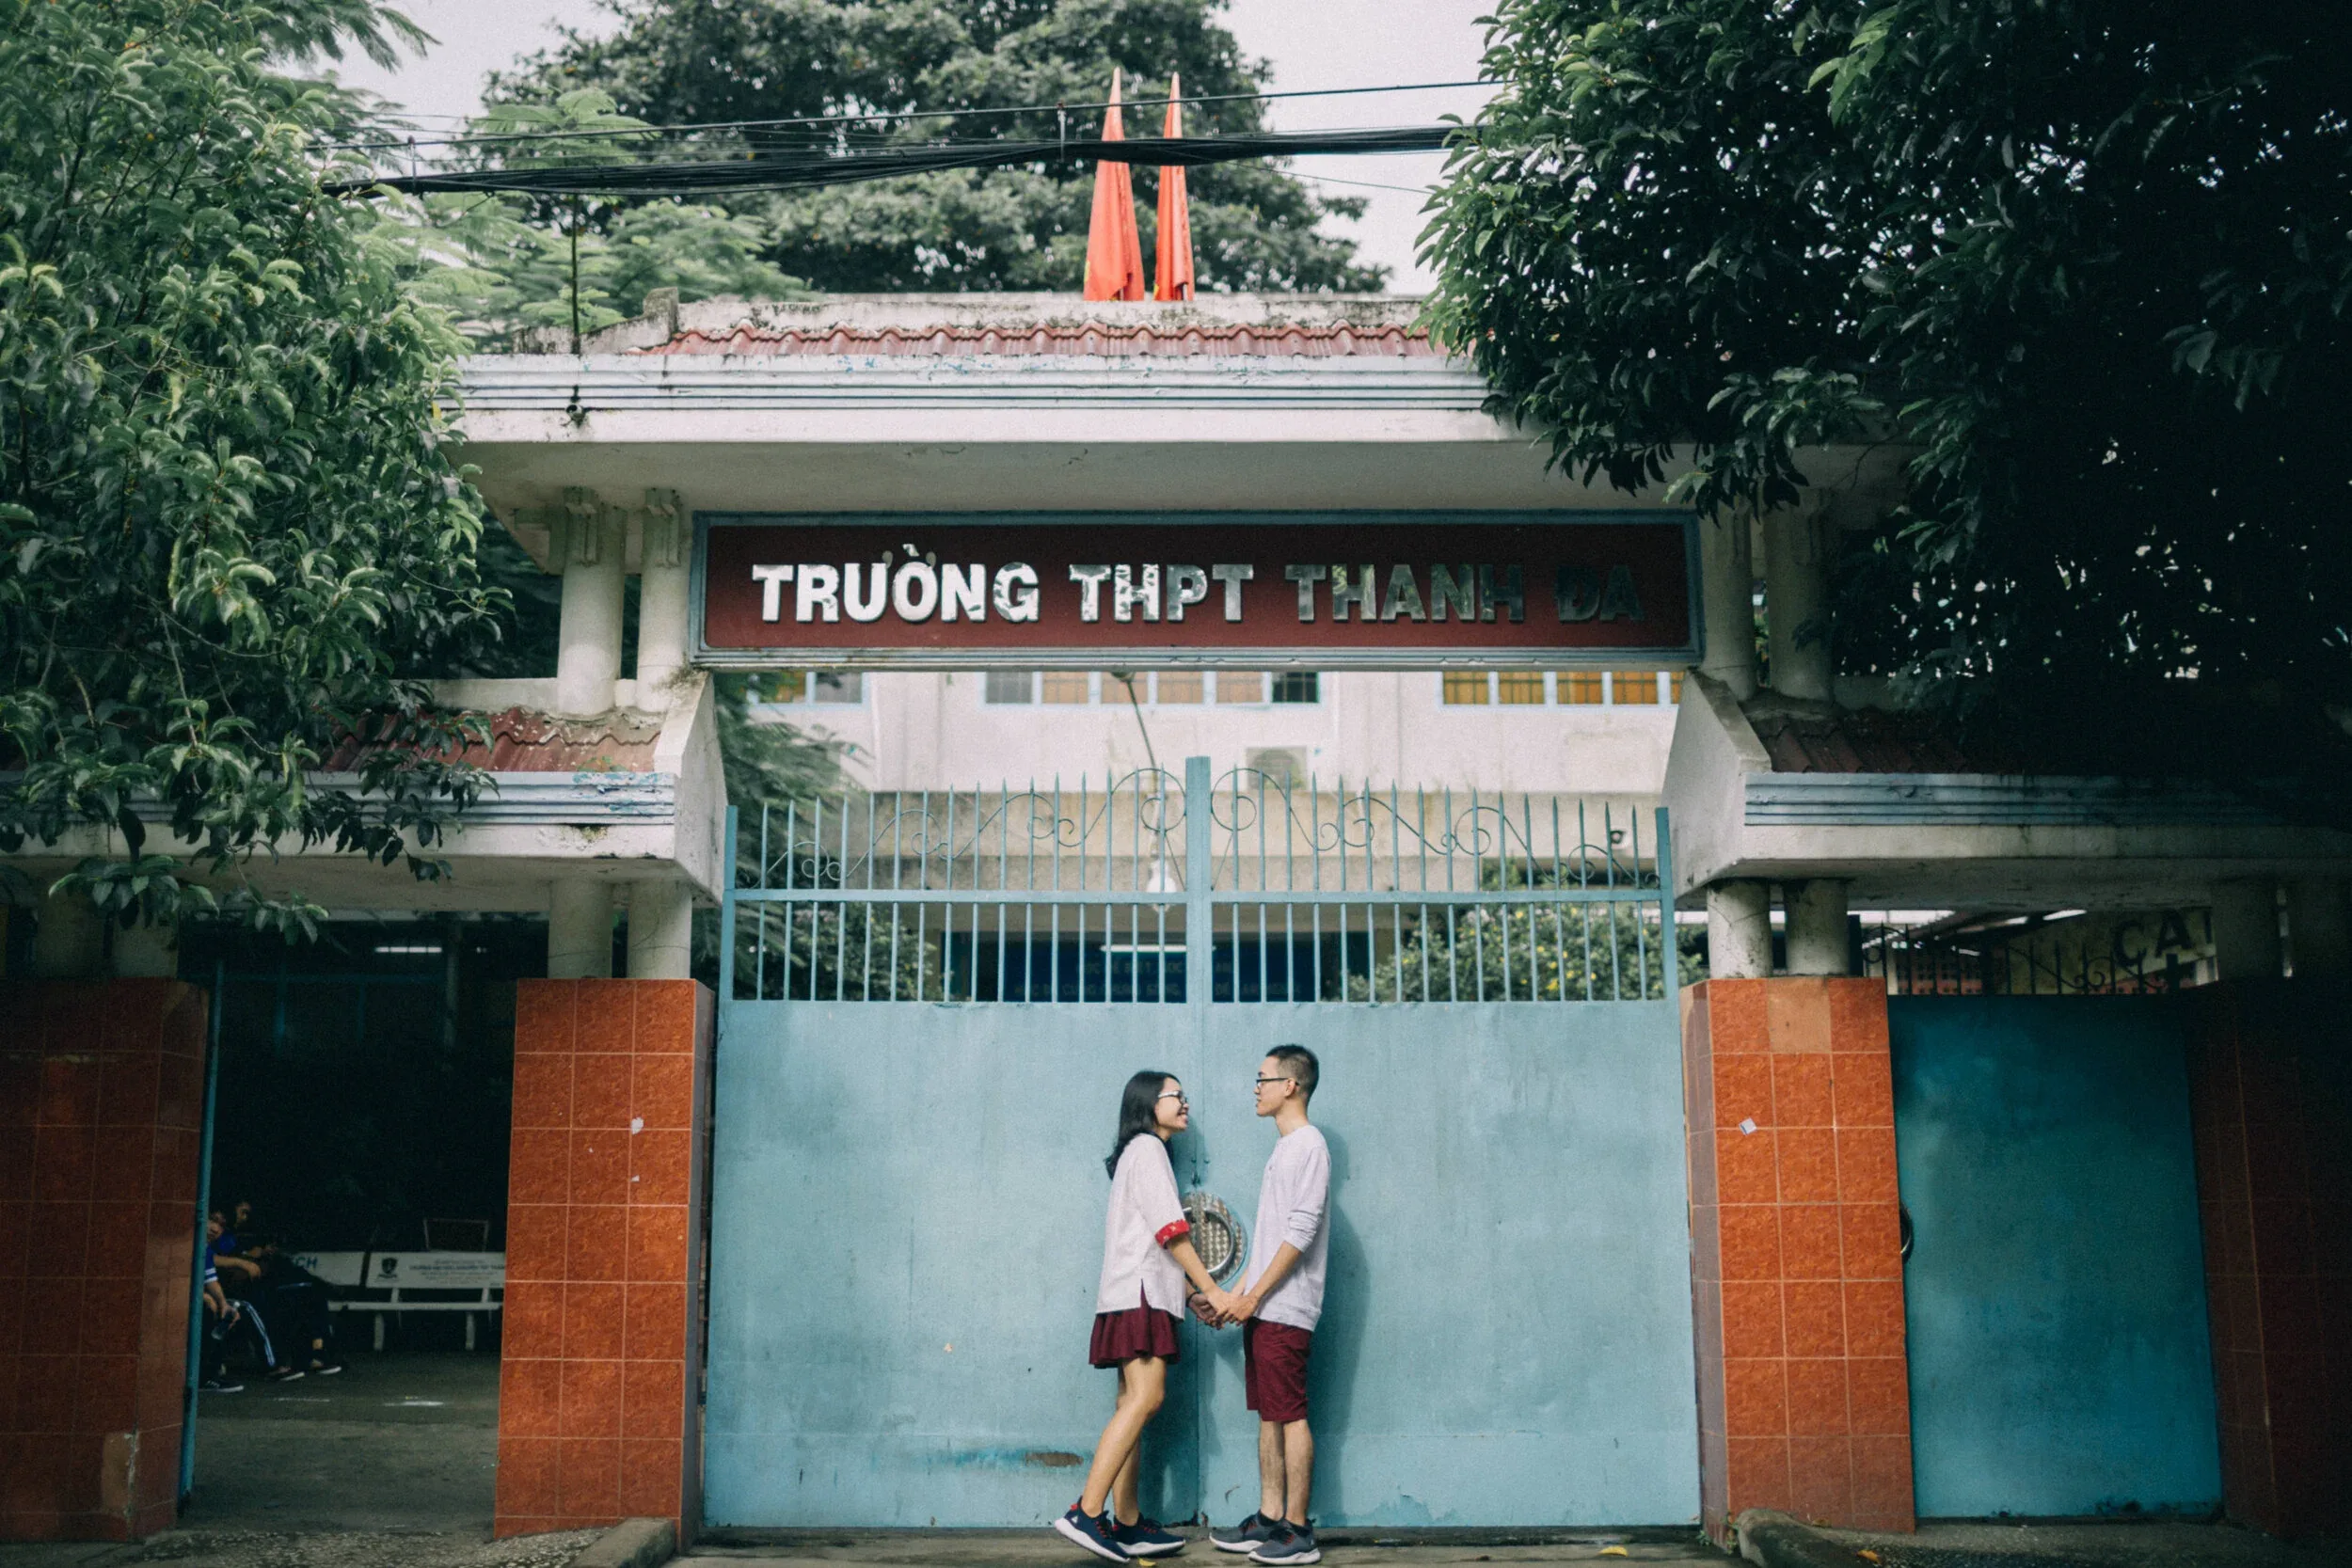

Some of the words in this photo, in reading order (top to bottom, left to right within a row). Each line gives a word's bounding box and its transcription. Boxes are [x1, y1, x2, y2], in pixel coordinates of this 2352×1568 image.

[752, 544, 1040, 623] TRƯỜNG
[1069, 563, 1254, 623] THPT
[1284, 563, 1524, 623] THANH
[2113, 910, 2212, 966] CA
